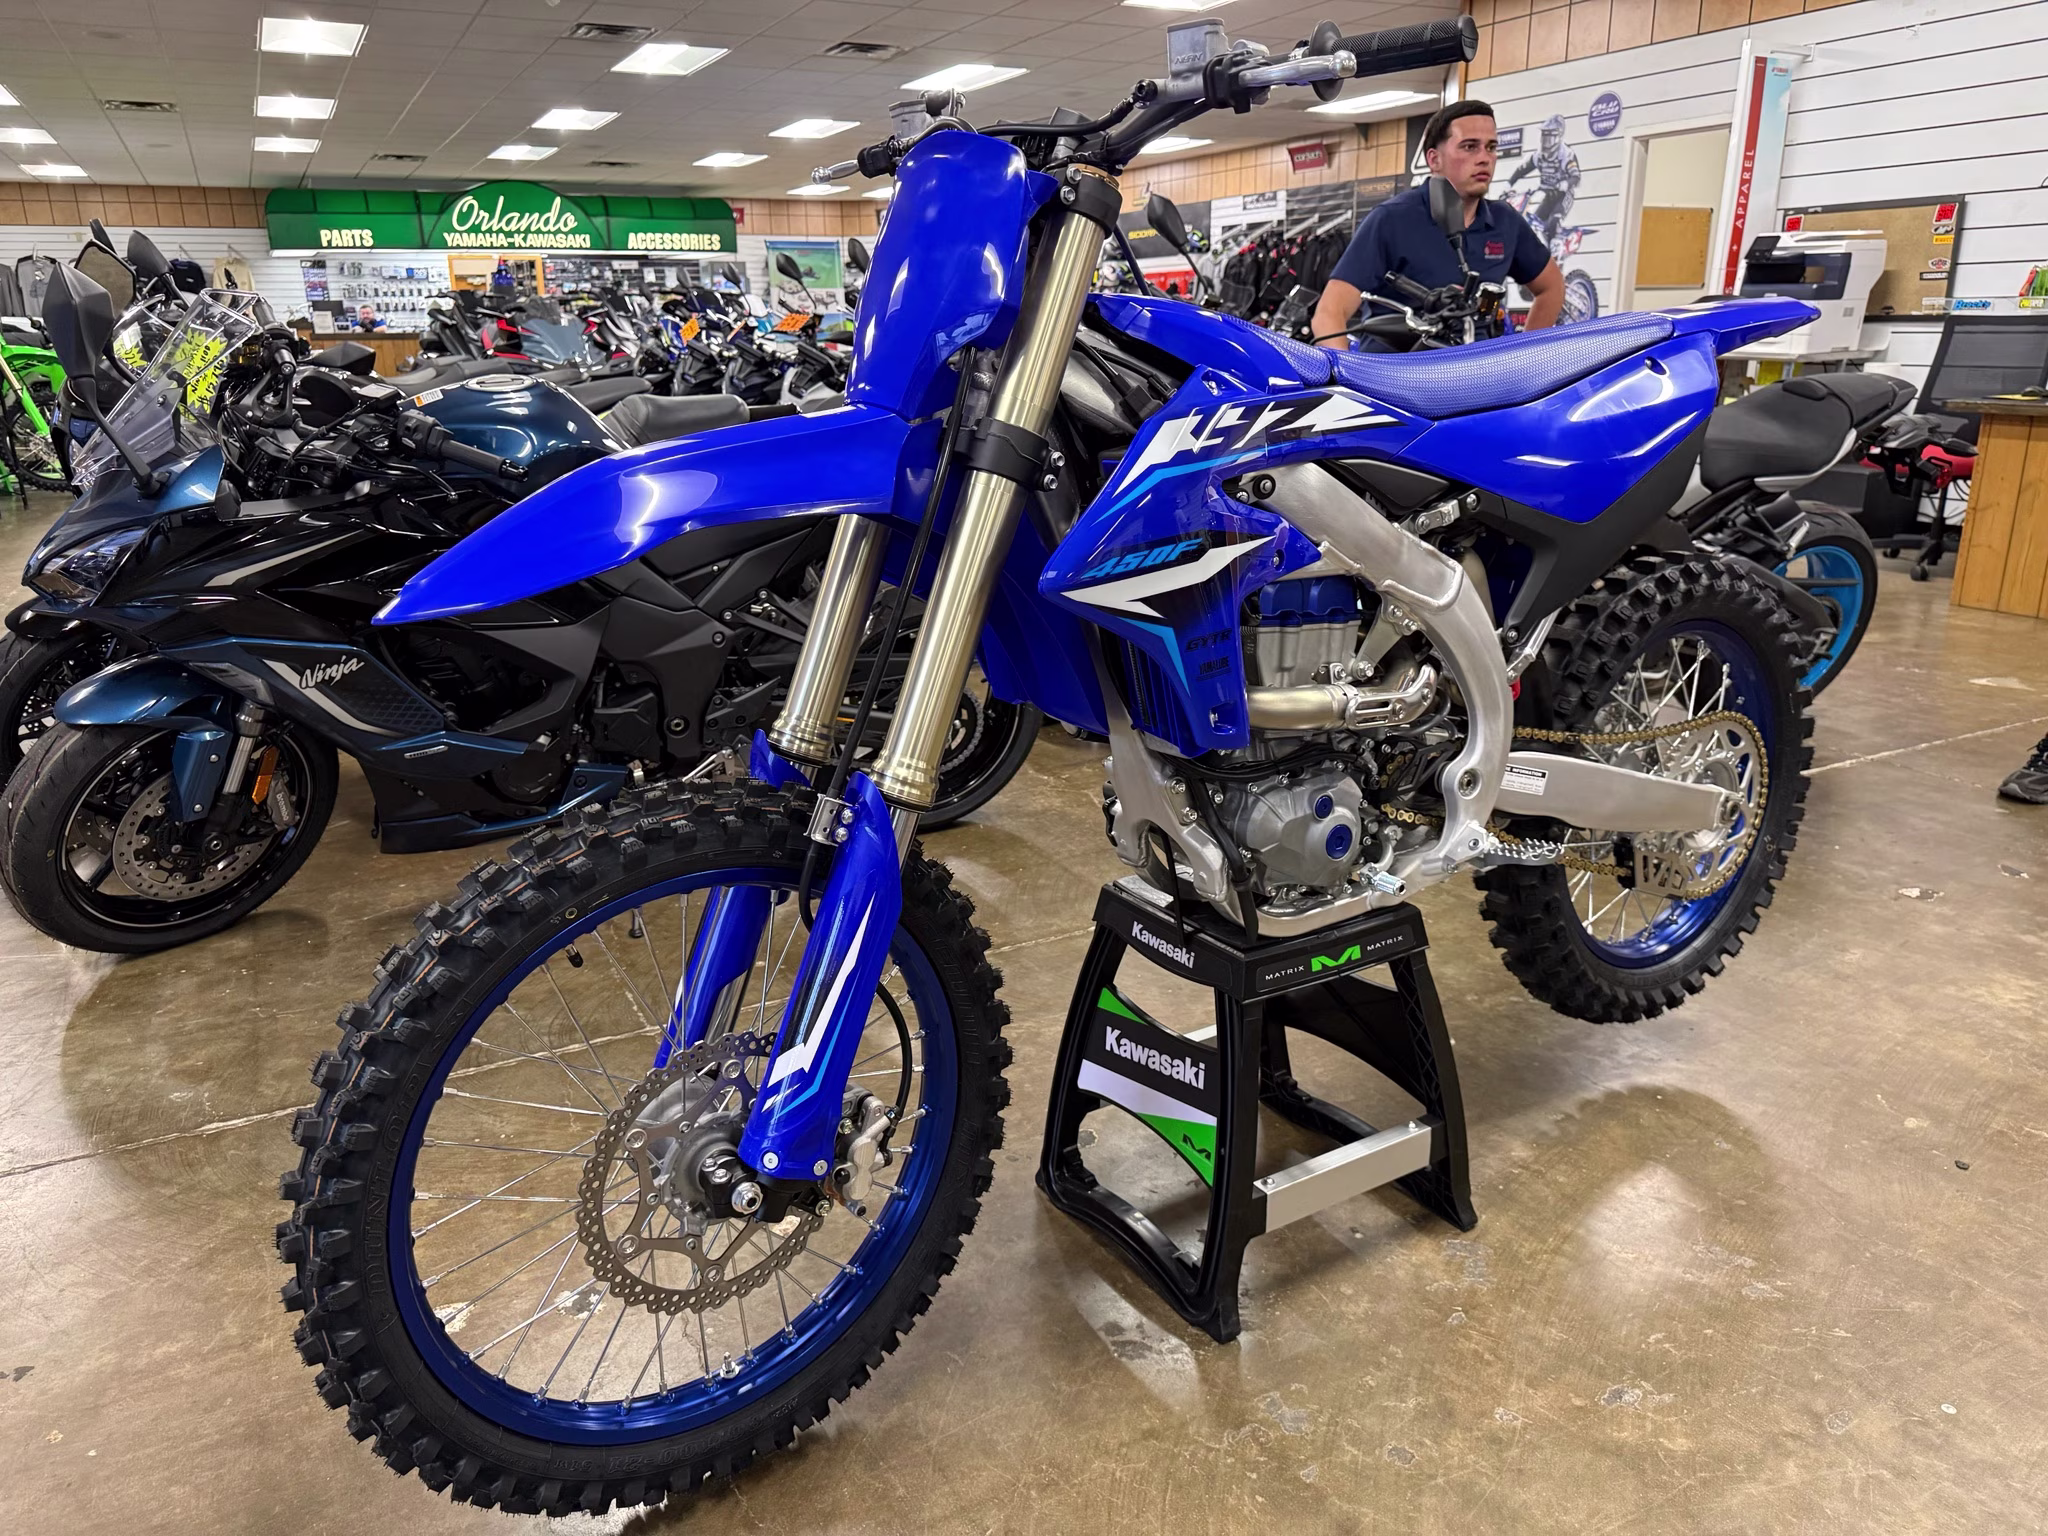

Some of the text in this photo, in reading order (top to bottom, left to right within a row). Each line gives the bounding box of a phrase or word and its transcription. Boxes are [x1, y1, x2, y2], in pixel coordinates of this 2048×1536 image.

[1735, 149, 1755, 229] APPAREL
[452, 195, 578, 232] Orlando
[320, 229, 374, 247] PARTS
[443, 232, 591, 249] YAMAHA-KAWASAKI
[627, 232, 721, 251] ACCESSORIES
[1080, 537, 1204, 580] 450F
[1184, 628, 1233, 653] GYTR
[301, 655, 365, 688] Ninja
[1199, 656, 1230, 675] YAMALUBE
[1131, 920, 1195, 969] Kawasaki
[1265, 965, 1306, 981] MATRIX
[1366, 935, 1404, 951] MATRIX
[1105, 1025, 1205, 1090] Kawasaki
